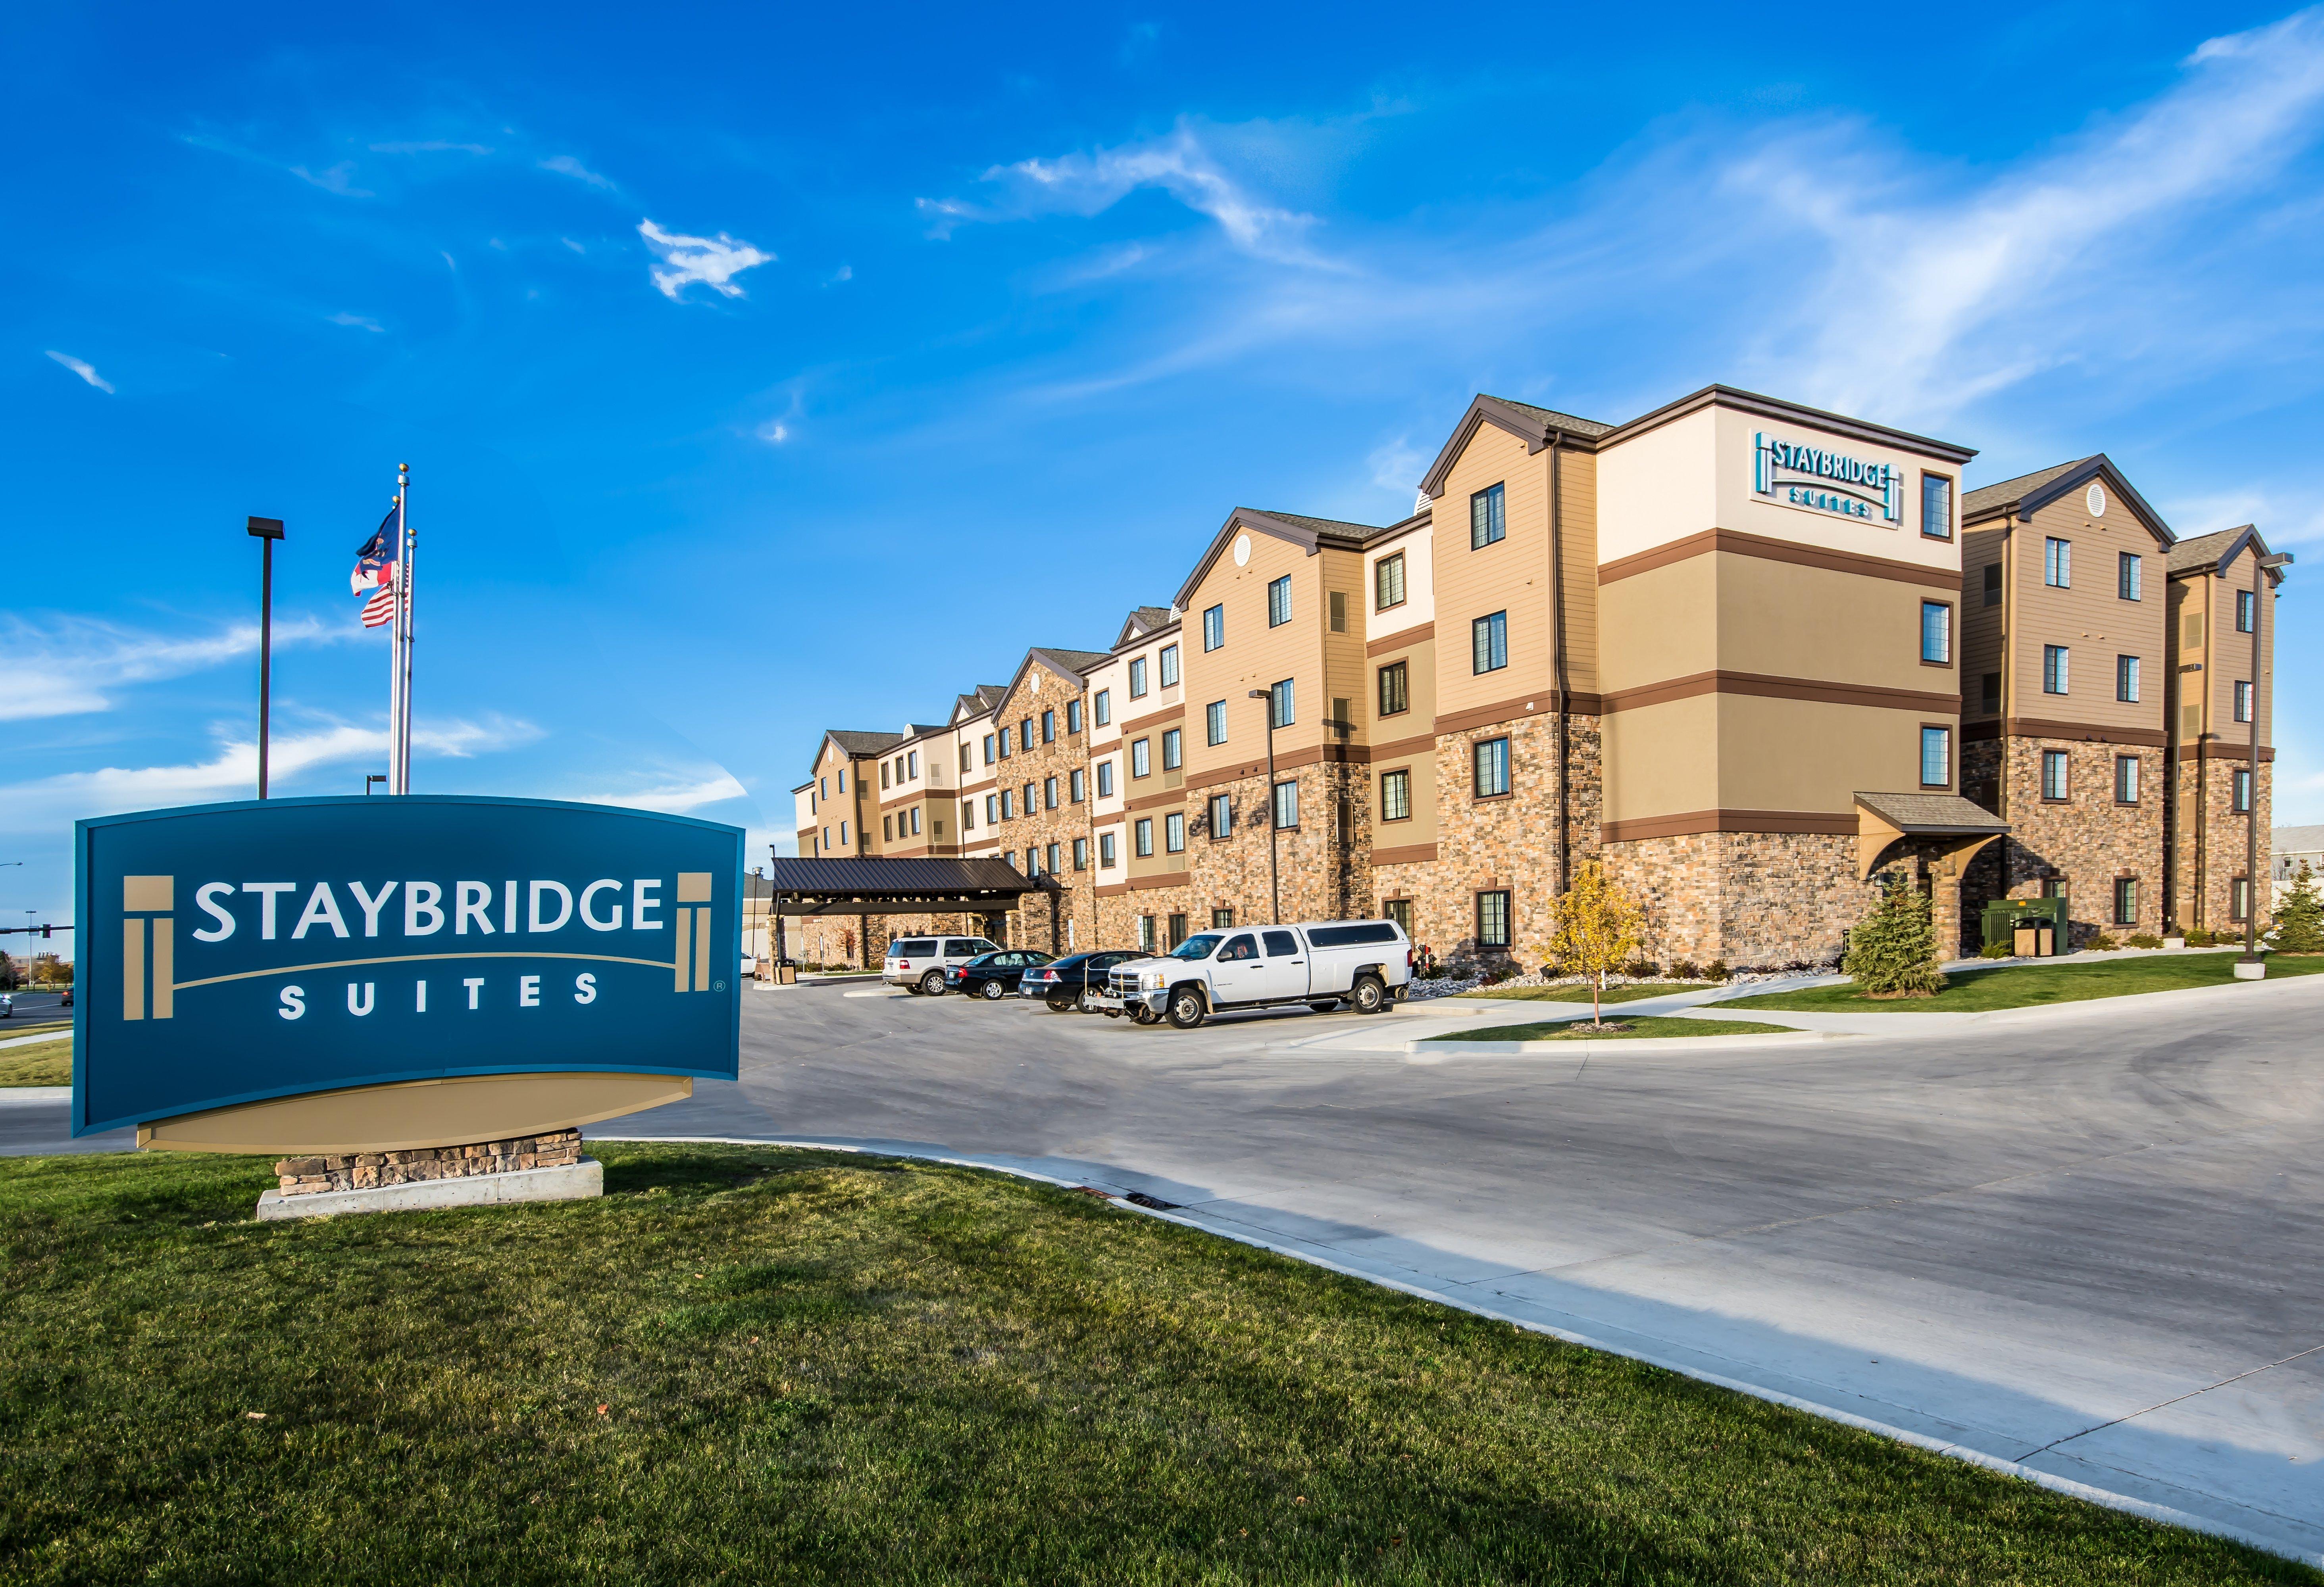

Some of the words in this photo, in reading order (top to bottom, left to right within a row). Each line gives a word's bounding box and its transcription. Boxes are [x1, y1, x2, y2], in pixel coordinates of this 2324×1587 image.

[1773, 440, 1886, 490] STAYBRIDGE
[1789, 486, 1869, 517] SUITES
[192, 879, 663, 942] STAYBRIDGE
[279, 973, 596, 1020] SUITES
